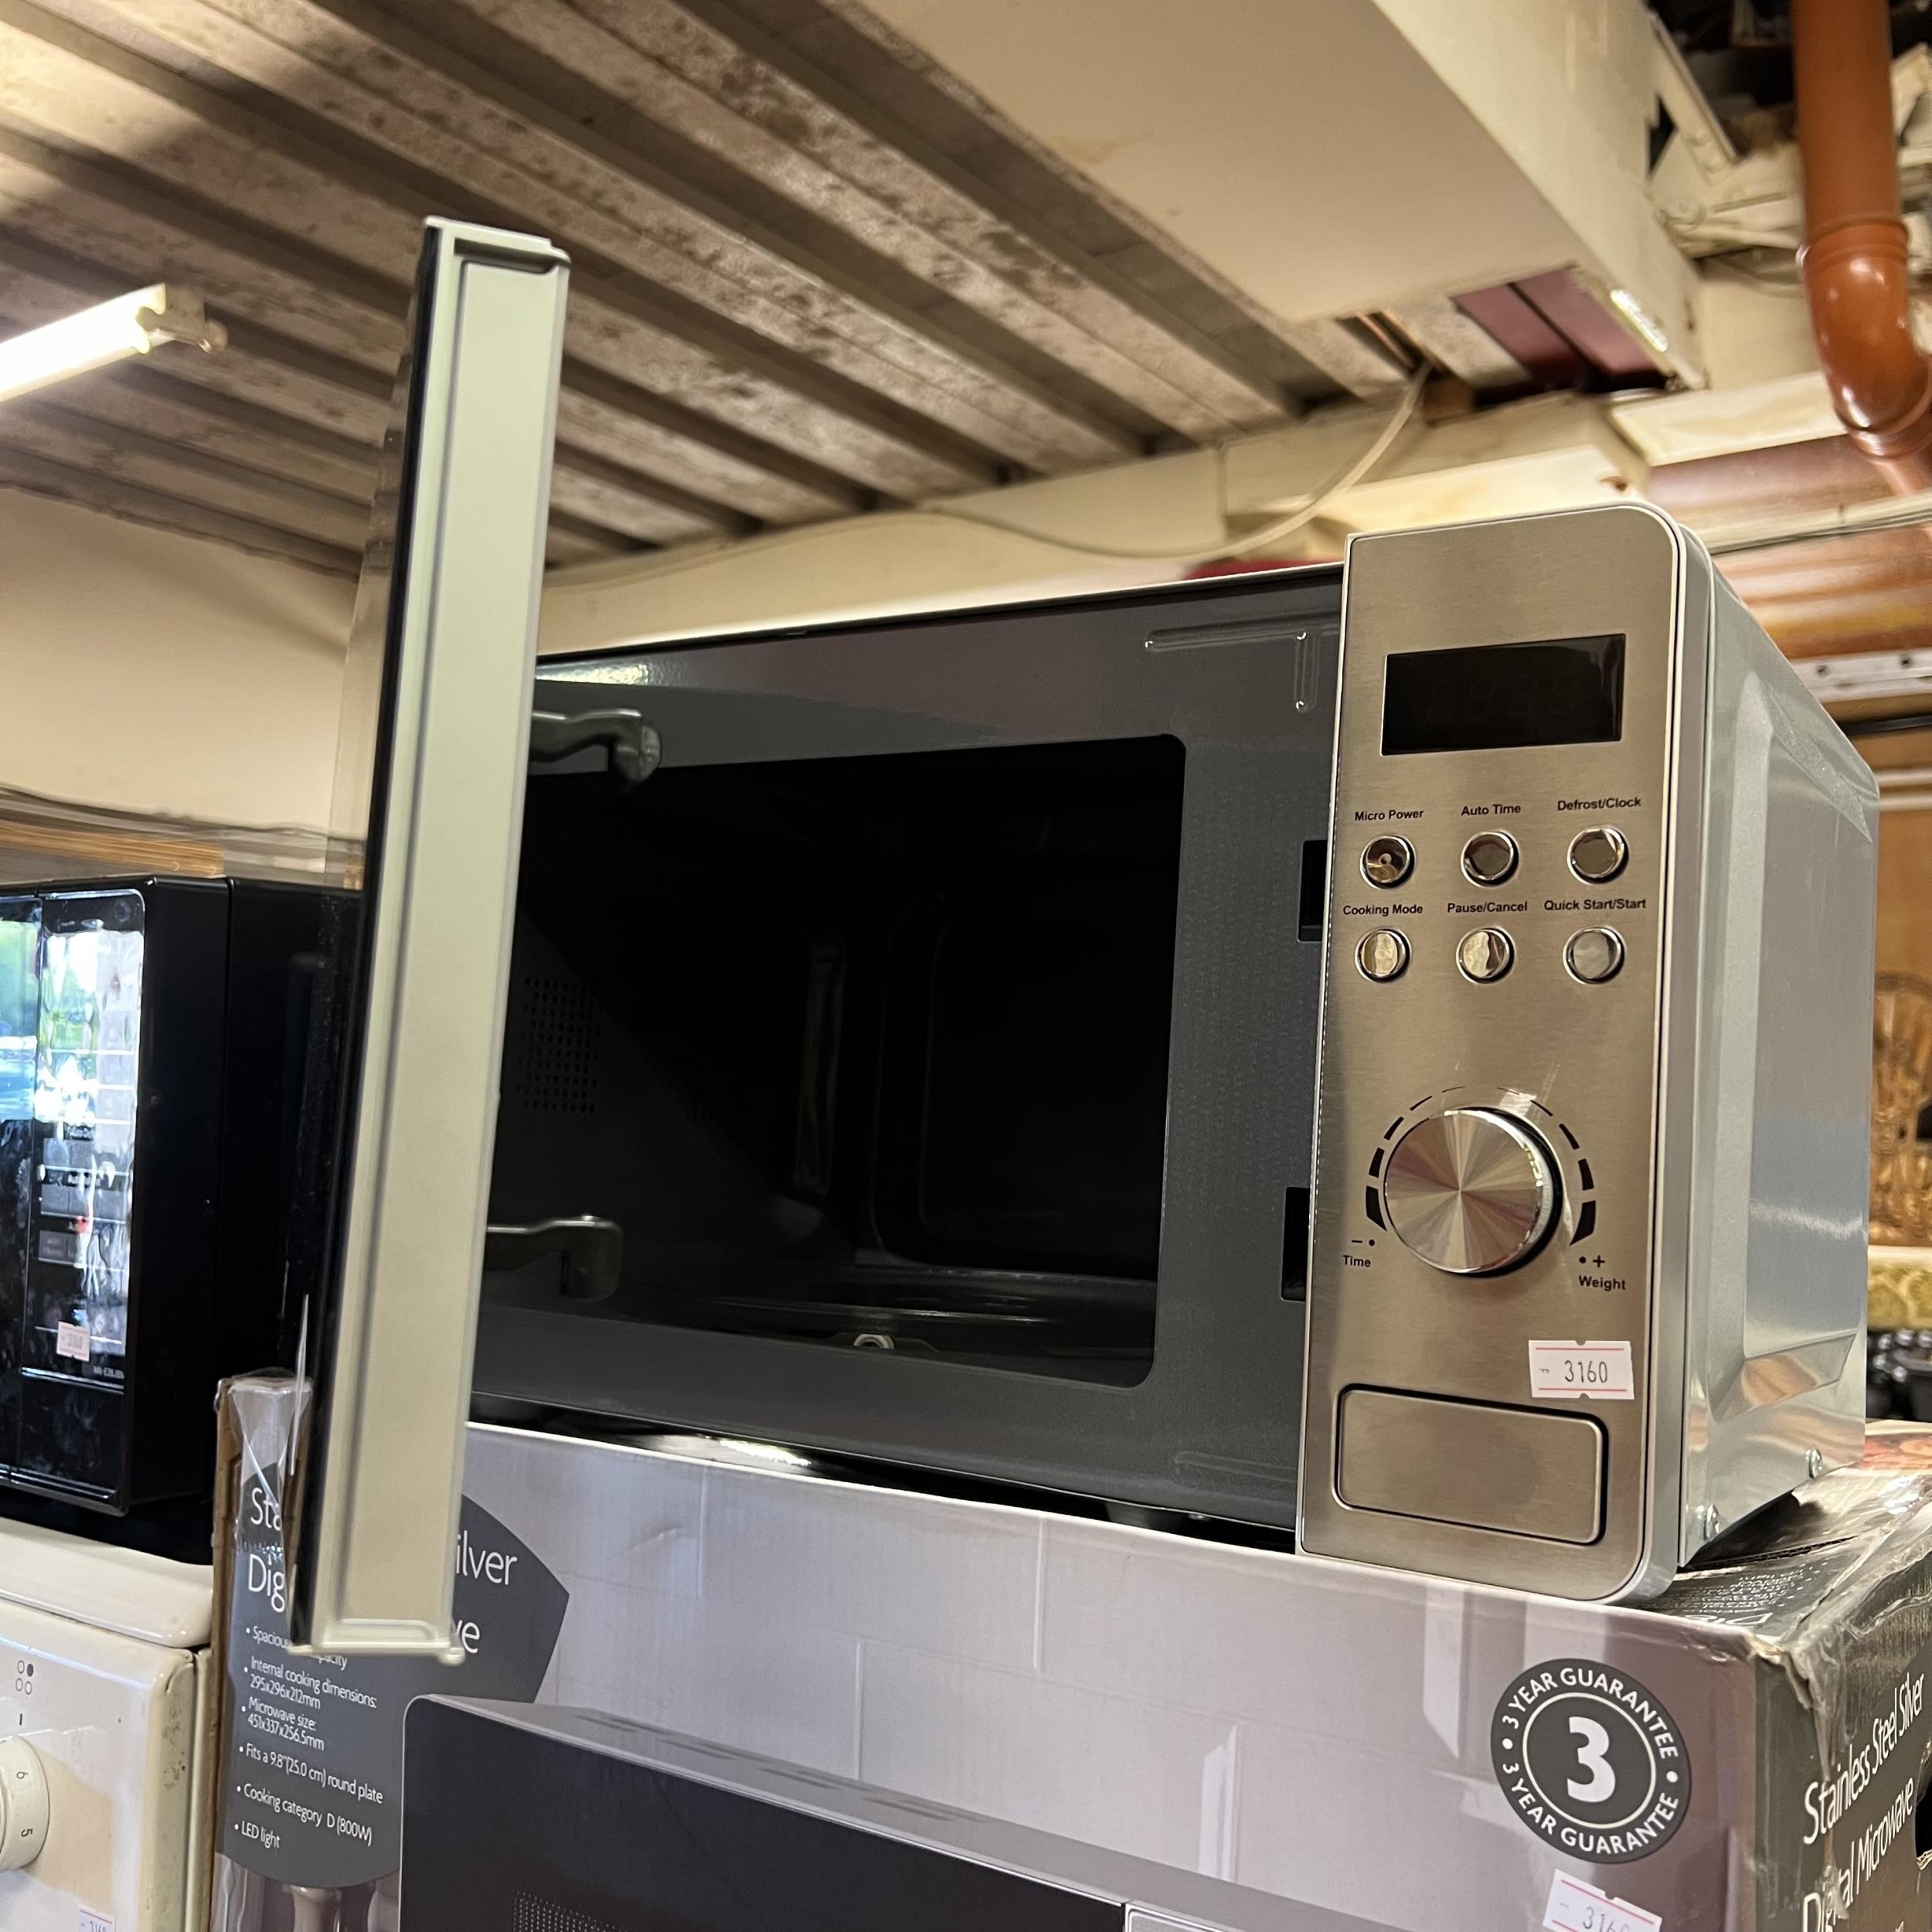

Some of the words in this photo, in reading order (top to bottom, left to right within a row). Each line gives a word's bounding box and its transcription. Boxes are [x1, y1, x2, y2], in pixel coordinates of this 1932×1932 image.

[1355, 811, 1386, 822] Micro
[1388, 808, 1424, 821] Power
[1461, 804, 1489, 817] Auto
[1492, 803, 1522, 815] Time
[1556, 797, 1642, 812] Defrost/Clock
[1342, 904, 1389, 917] Cooking
[1392, 903, 1423, 916] Mode
[1447, 900, 1528, 913] Pause/Cancel
[1544, 899, 1580, 912] Quick
[1583, 898, 1647, 910] Start/Start
[1342, 1254, 1371, 1268] Time
[1579, 1274, 1626, 1291] Weight
[1564, 1359, 1608, 1384] 3160
[456, 1529, 518, 1586] ilver
[251, 1655, 284, 1679] Internal
[284, 1667, 321, 1695] cooking
[322, 1678, 377, 1709] dimensions:
[1508, 1672, 1559, 1713] YEAR
[248, 1696, 296, 1725] Microwave
[298, 1713, 317, 1731] size:
[1502, 1715, 1519, 1730] 3
[1560, 1668, 1679, 1760] GUARANTEE
[1566, 1716, 1616, 1803] 3
[1803, 1743, 1871, 1845] Stainless
[1872, 1687, 1898, 1775] Steel
[1899, 1672, 1924, 1737] Silver
[246, 1743, 262, 1760] Fits
[263, 1751, 268, 1763] a
[309, 1768, 326, 1787] cm)
[328, 1775, 357, 1795] round
[358, 1783, 383, 1804] plate
[243, 1783, 281, 1814] Cooking
[282, 1798, 323, 1827] category
[326, 1813, 335, 1828] D
[336, 1815, 372, 1847] (800W)
[1502, 1762, 1519, 1774] 3
[1511, 1777, 1557, 1835] YEAR
[1560, 1792, 1679, 1855] GUARANTEE
[21, 1828, 33, 1838] 5
[241, 1820, 260, 1839] LED
[260, 1825, 281, 1849] light
[1856, 1777, 1914, 1895] Microwave
